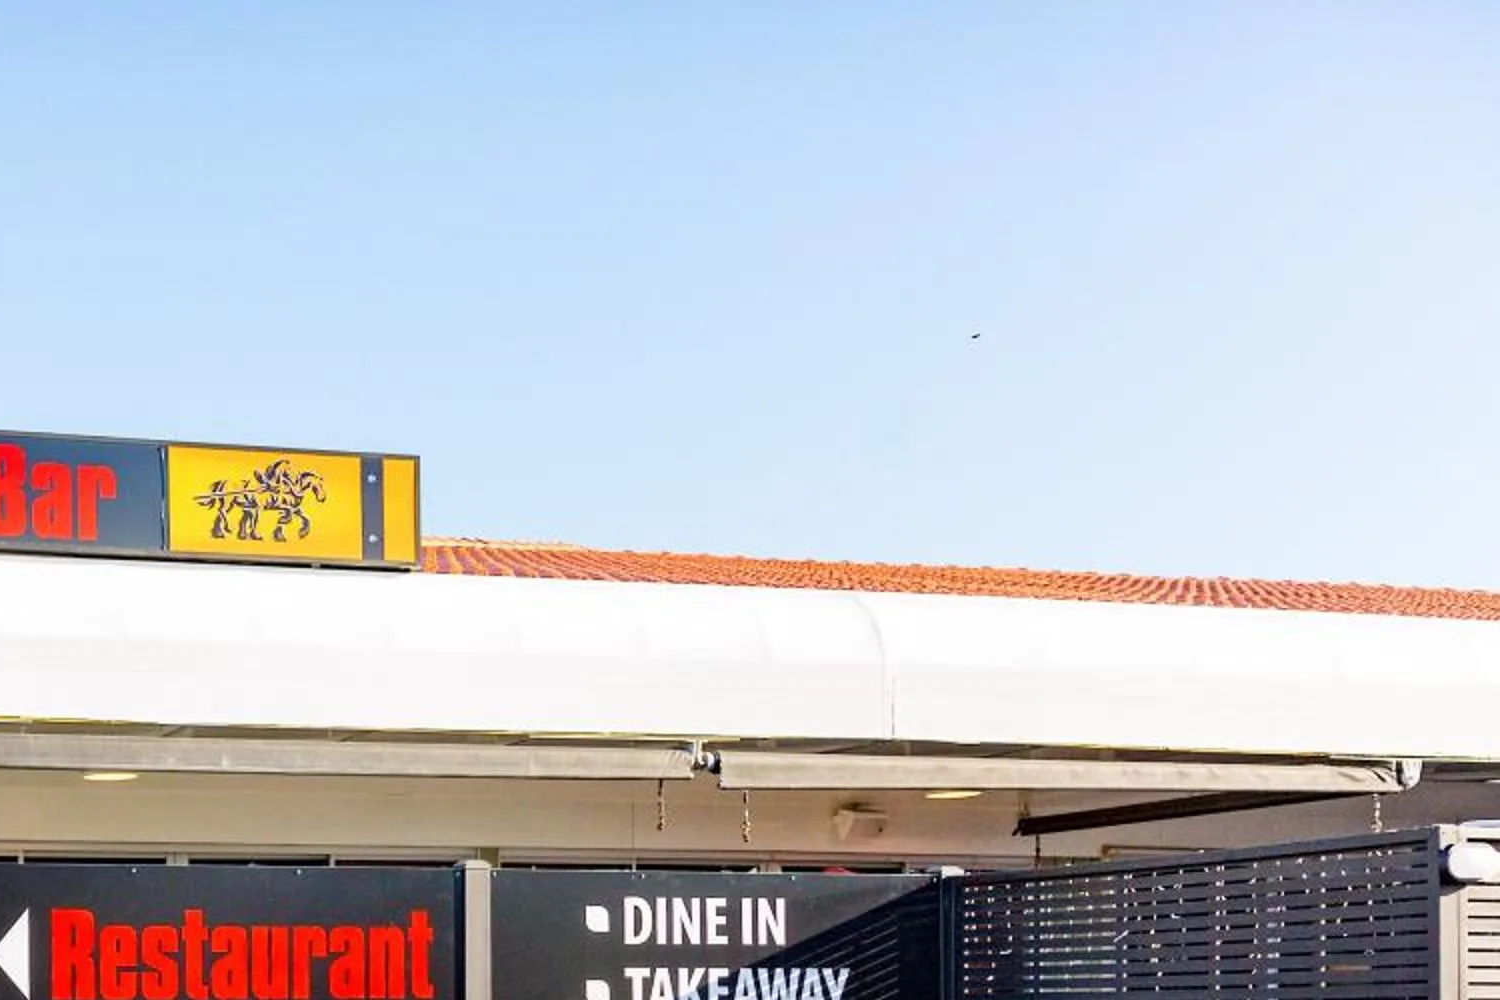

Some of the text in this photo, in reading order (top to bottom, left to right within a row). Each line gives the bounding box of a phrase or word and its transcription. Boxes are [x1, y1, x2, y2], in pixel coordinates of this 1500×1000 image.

[49, 908, 435, 1000] Restaurant
[623, 897, 787, 945] DINE IN
